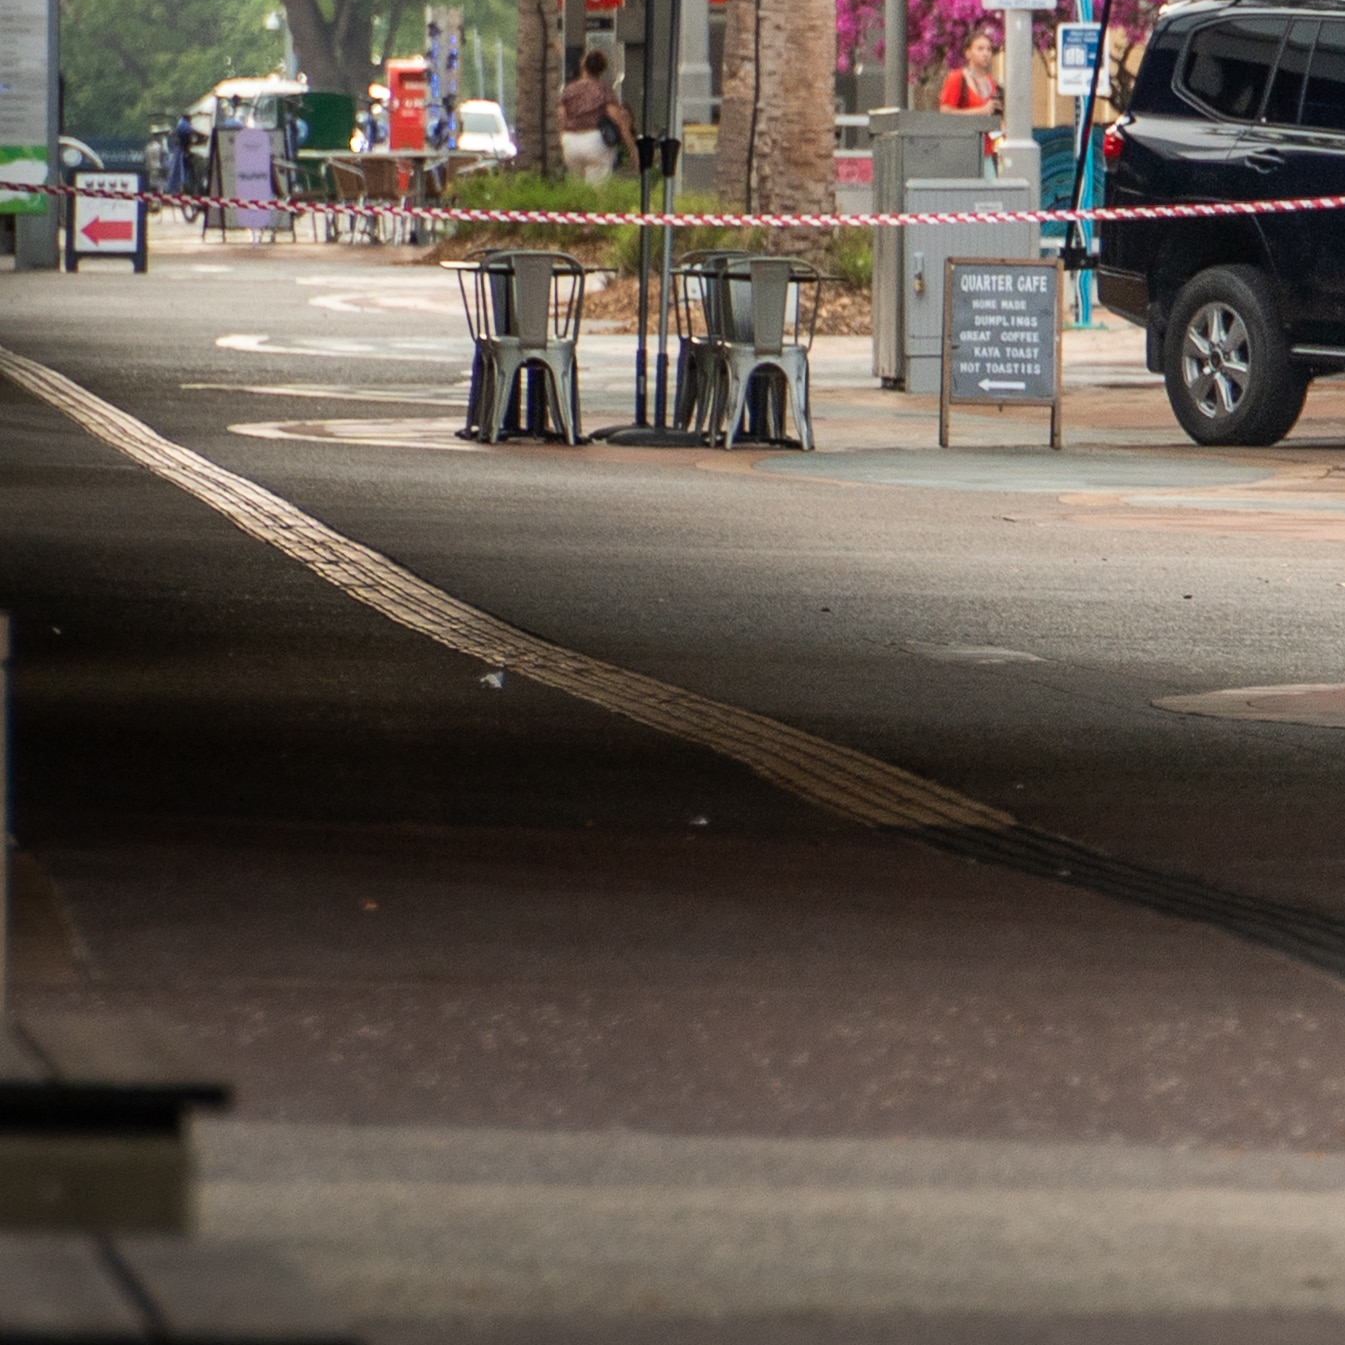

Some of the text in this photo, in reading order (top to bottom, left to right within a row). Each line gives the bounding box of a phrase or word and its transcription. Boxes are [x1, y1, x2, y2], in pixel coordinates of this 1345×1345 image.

[960, 274, 1013, 292] QUARTER
[974, 315, 1038, 327] DUMPLINGS
[959, 330, 1039, 342] GREAT COFFEE
[974, 347, 1039, 360] KAYA TOAST
[960, 362, 1041, 375] HOT TOASTIES
